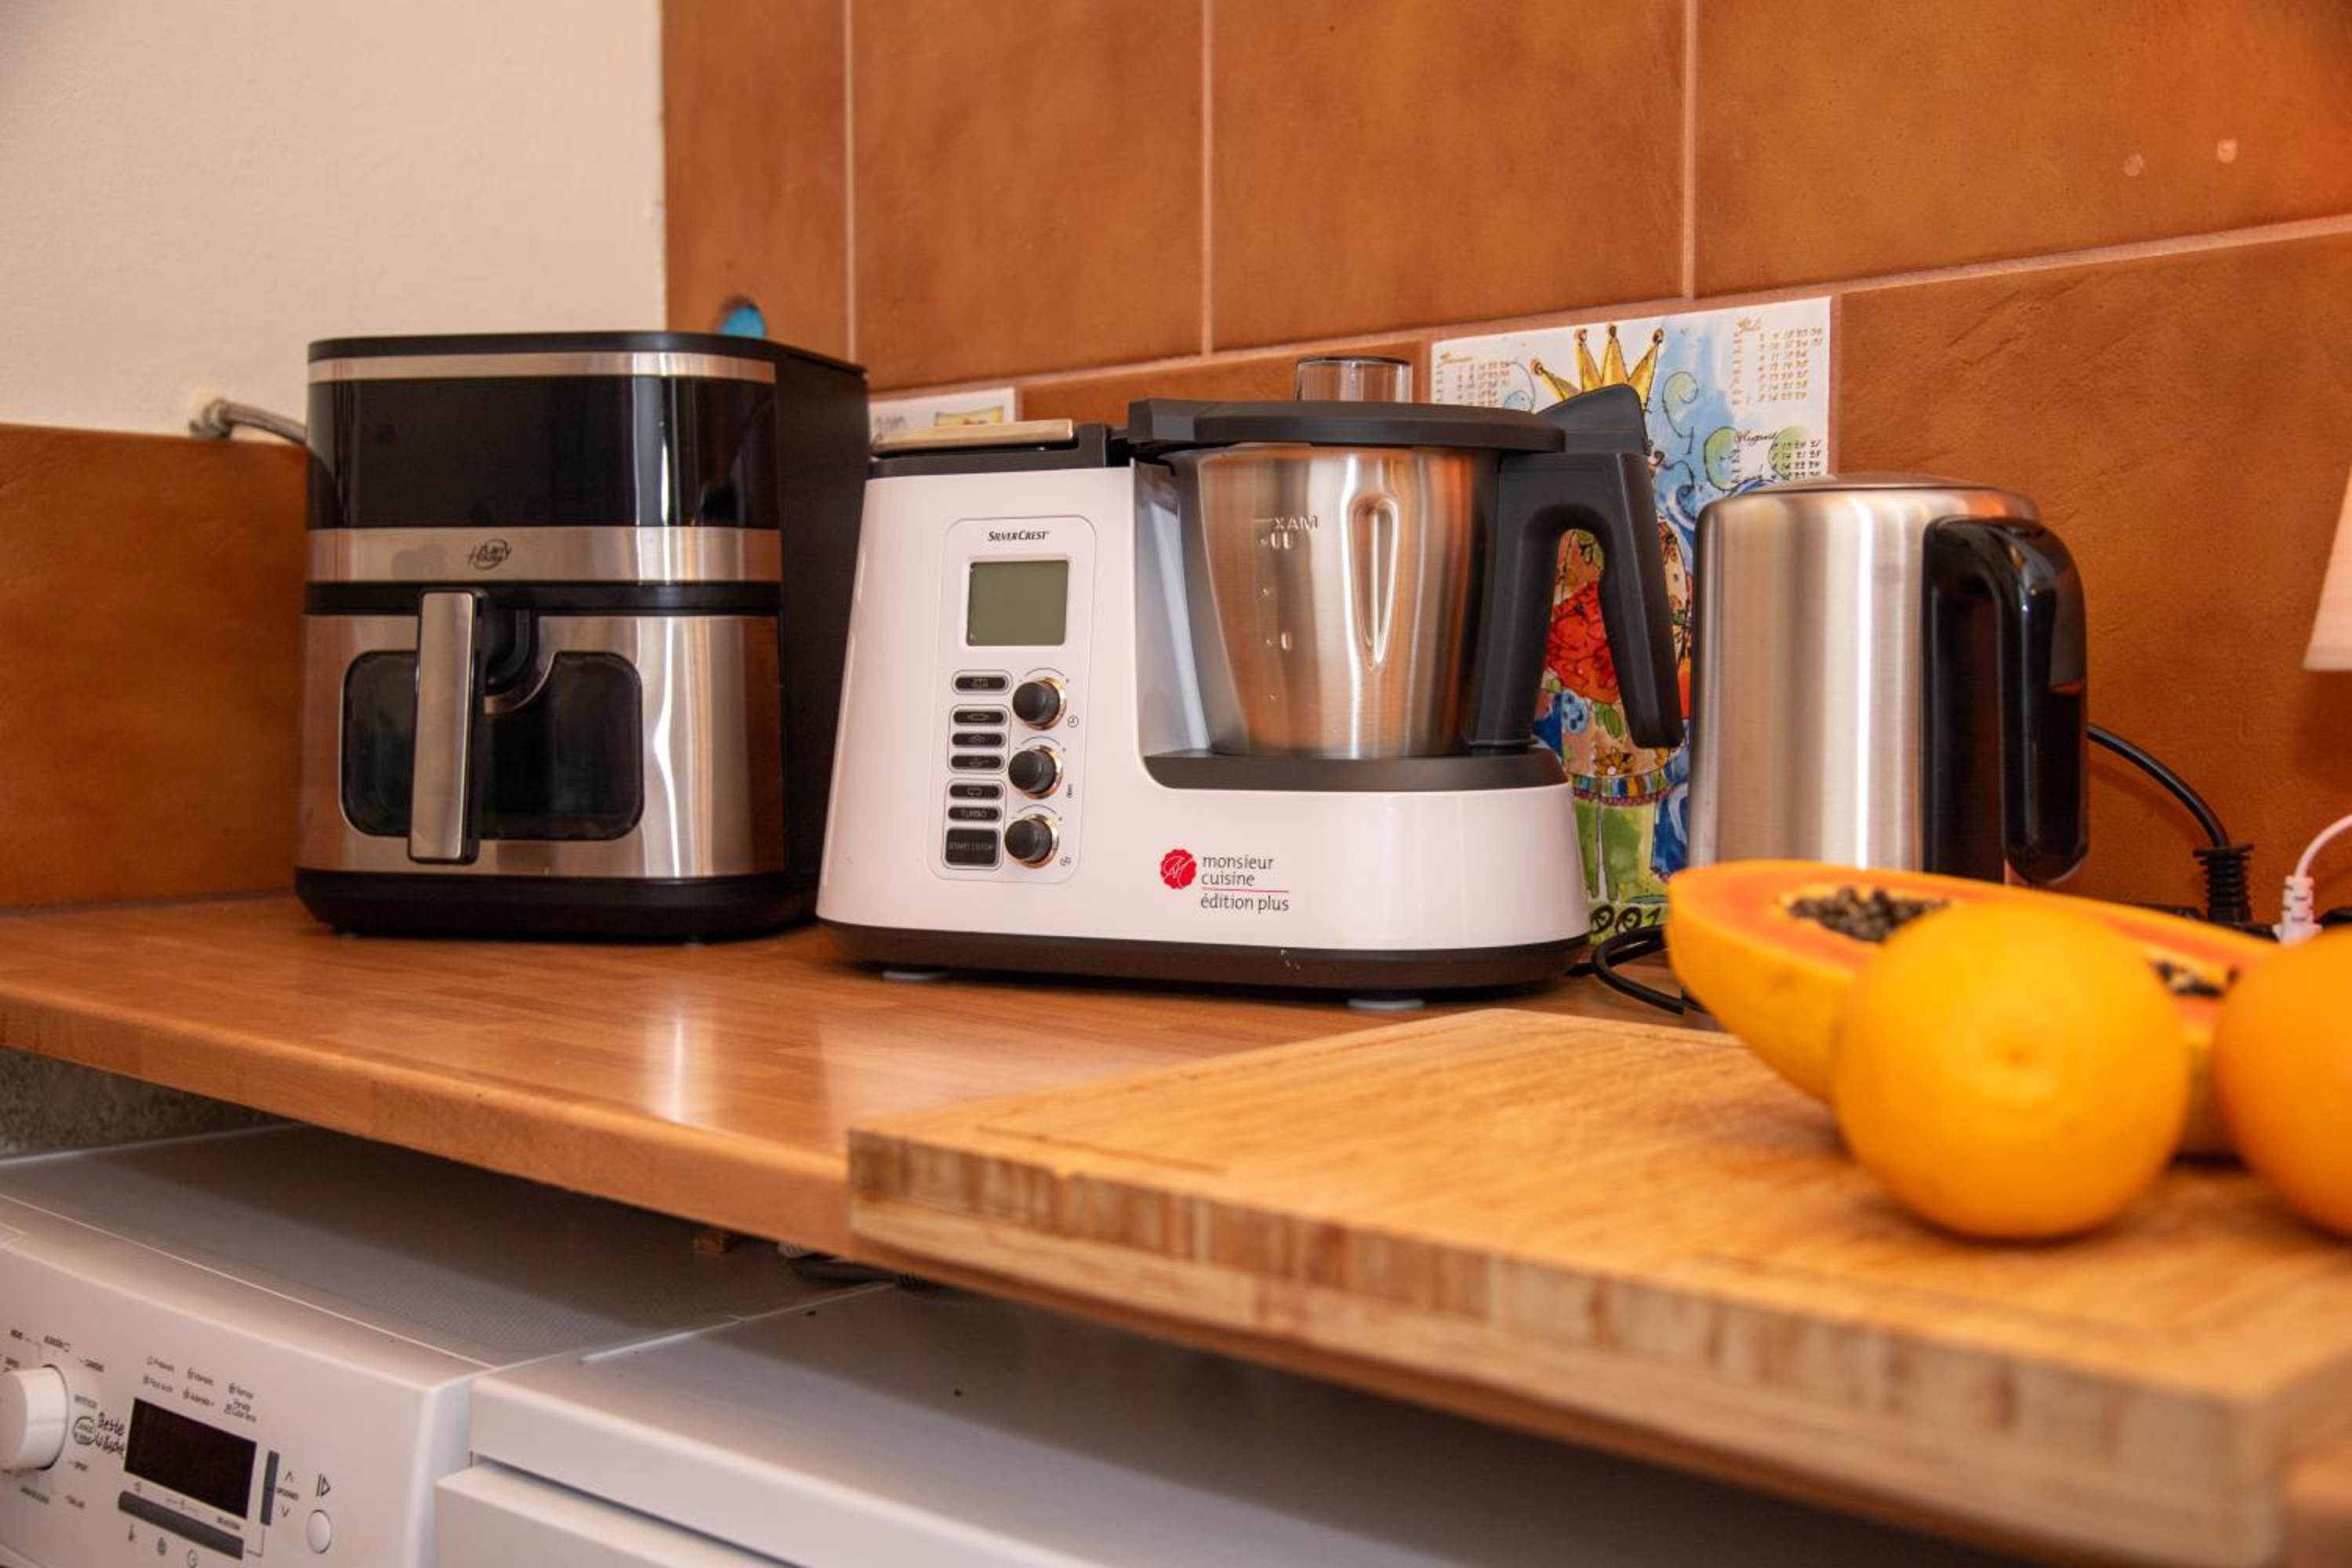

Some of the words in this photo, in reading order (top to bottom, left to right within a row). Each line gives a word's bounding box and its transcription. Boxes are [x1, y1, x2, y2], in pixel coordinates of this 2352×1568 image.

[1203, 855, 1274, 869] monsieur
[1201, 872, 1255, 886] cuisine
[1200, 893, 1254, 909] édition
[1258, 895, 1290, 913] plus
